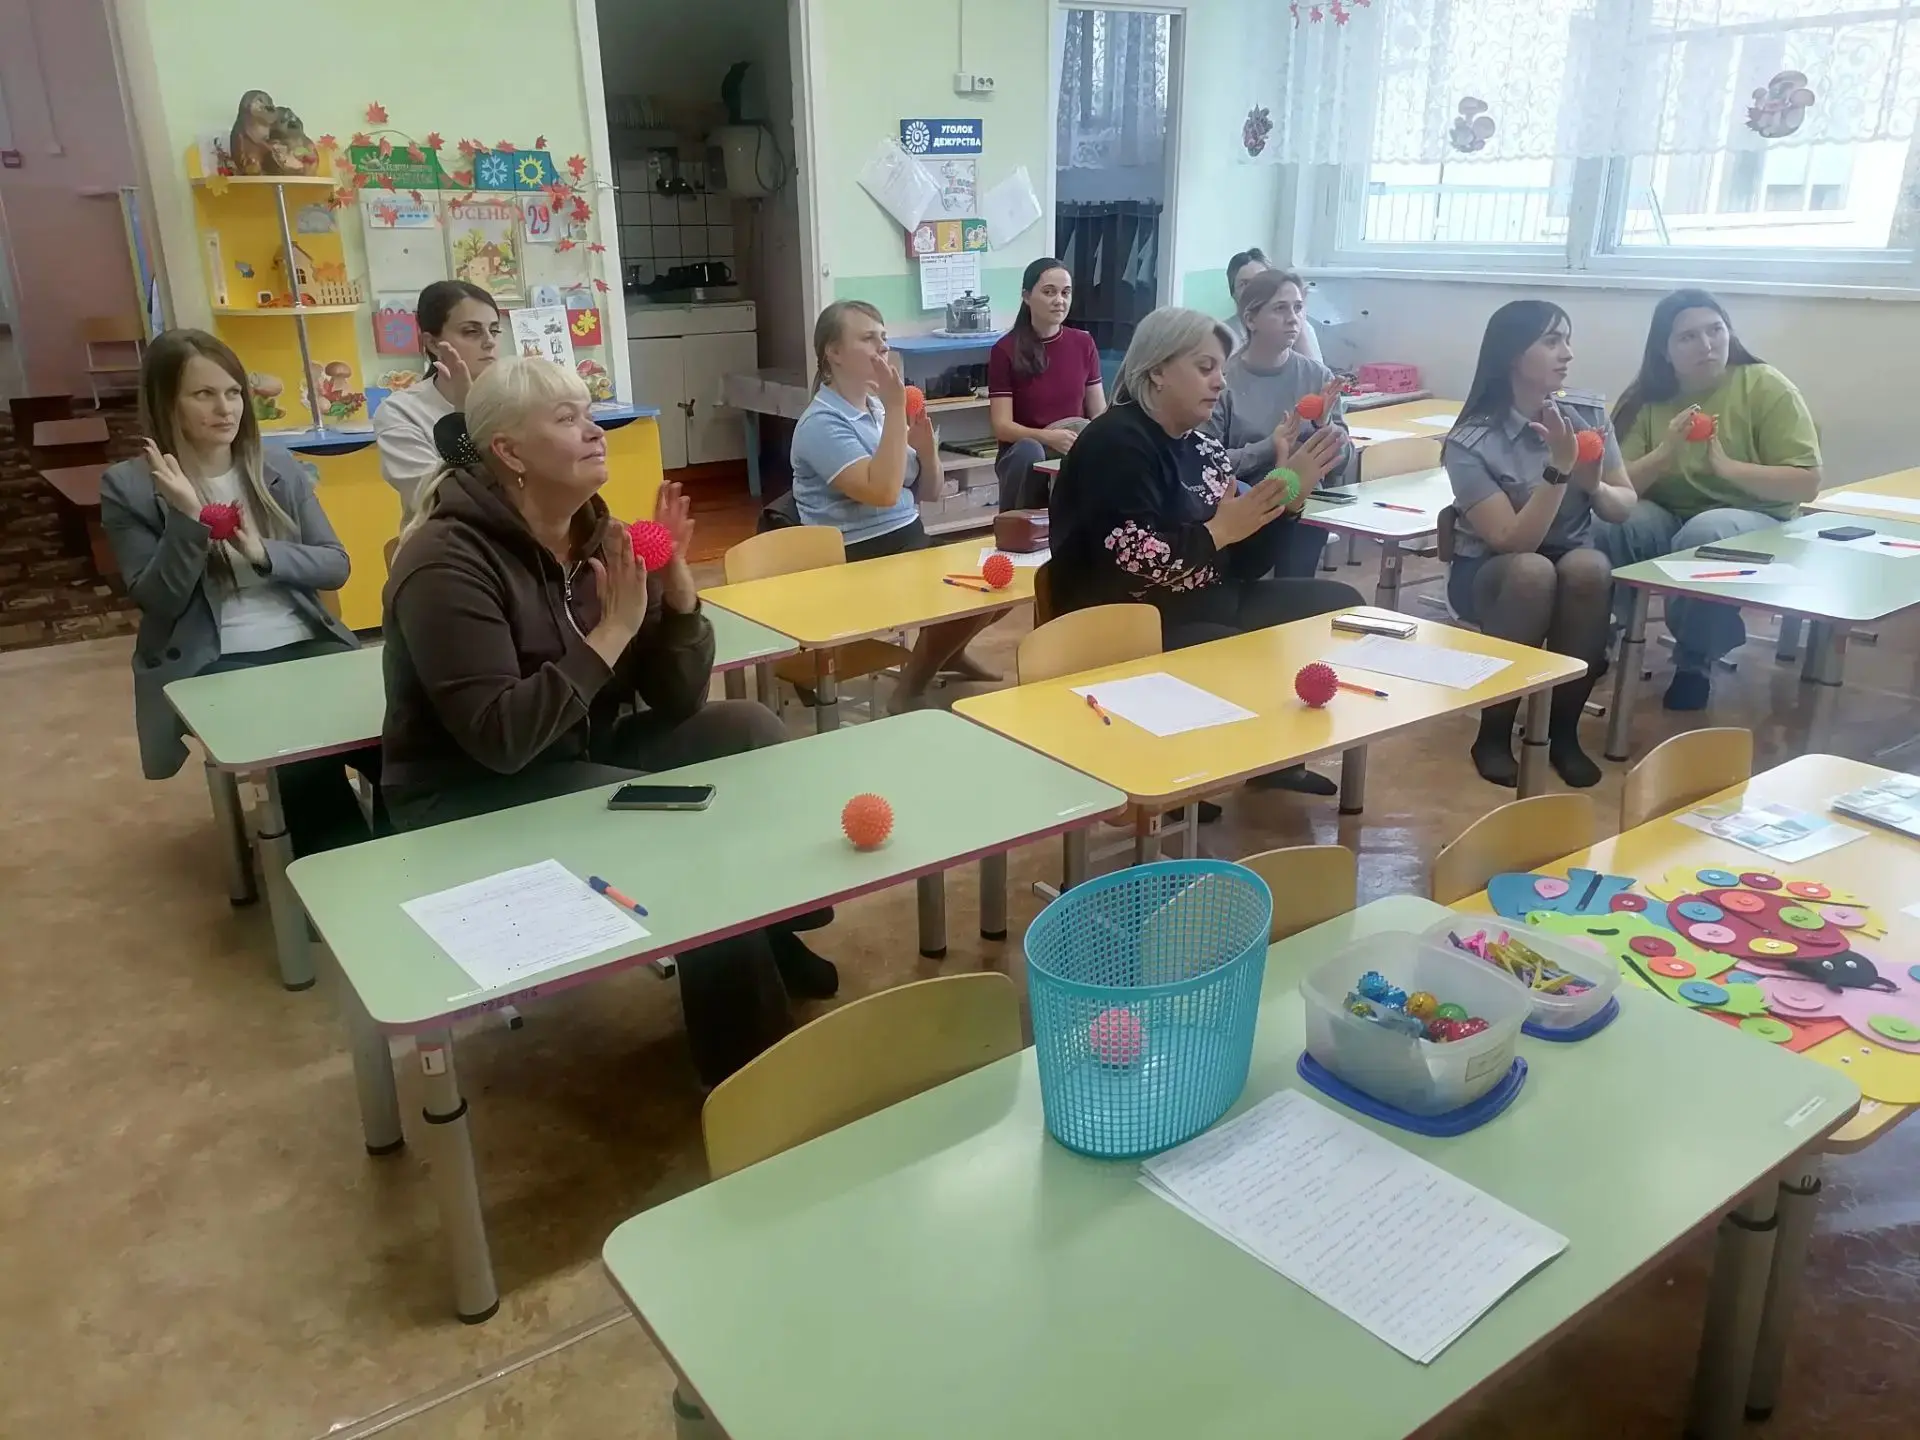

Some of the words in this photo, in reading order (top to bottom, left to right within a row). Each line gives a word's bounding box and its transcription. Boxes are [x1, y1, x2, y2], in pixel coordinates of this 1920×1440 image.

[941, 125, 974, 134] УГОЛОК
[933, 137, 981, 147] ДЕЖУРСТВА
[452, 206, 510, 220] ОСЕНЬ
[528, 204, 550, 235] 29
